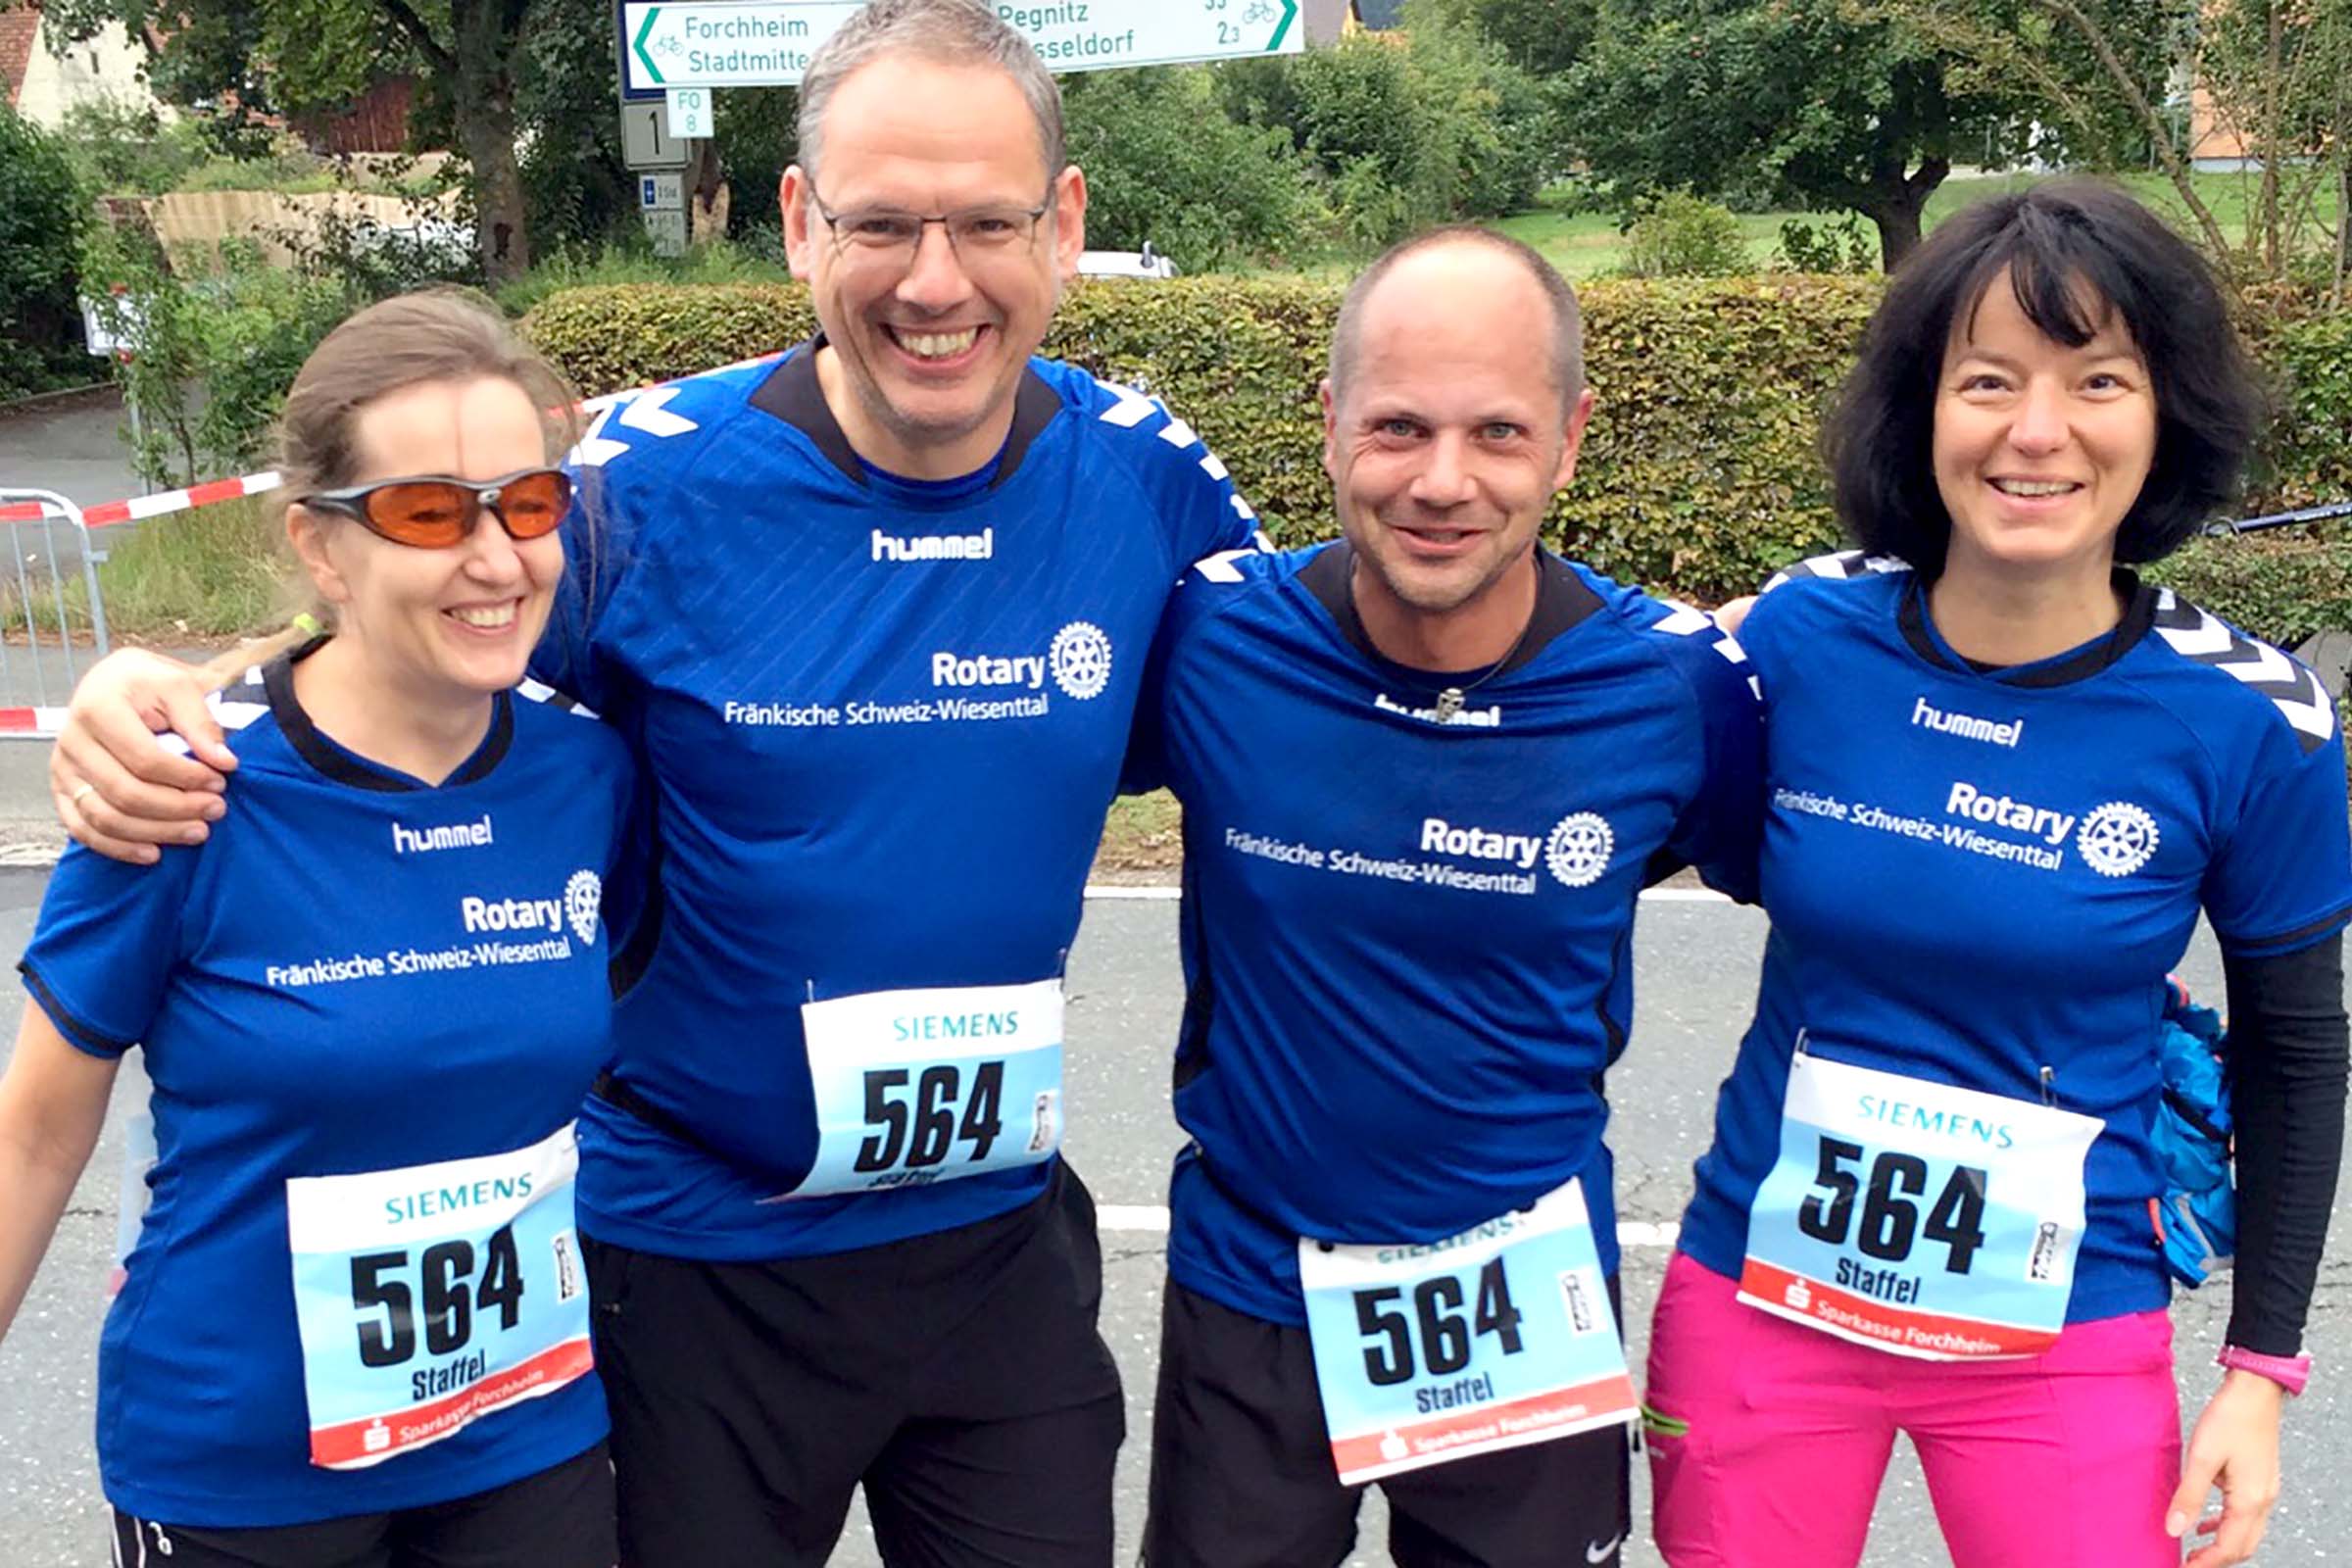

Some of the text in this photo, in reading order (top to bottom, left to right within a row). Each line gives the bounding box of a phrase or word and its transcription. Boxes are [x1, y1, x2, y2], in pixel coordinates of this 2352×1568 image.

[685, 14, 808, 38] Forchheim
[999, 3, 1089, 32] Pegnitz
[689, 49, 809, 73] Stadtmitte
[1033, 29, 1135, 60] sseldorf
[677, 91, 701, 110] FO
[649, 111, 661, 155] 1
[685, 115, 697, 132] 8
[872, 527, 993, 562] hummel
[932, 653, 1045, 689] Rotary
[724, 694, 1049, 726] Fränkische Schweiz-Wiesenttal
[1912, 698, 2023, 747] hummel
[392, 814, 493, 854] hummel
[1946, 782, 2076, 845] Rotary
[1420, 818, 1543, 868] Rotary
[1848, 803, 2062, 870] Schweiz-Wiesenttal
[1226, 828, 1536, 895] Fränkische Schweiz-Wiesenttal
[463, 897, 563, 933] Rotary
[267, 936, 571, 987] Fränkische Schweiz-Wiesenttal
[893, 1011, 1019, 1041] SIEMENS
[854, 1060, 1005, 1172] 564
[1858, 1096, 2014, 1149] SIEMENS
[386, 1172, 533, 1224] SIEMENS
[1798, 1135, 1988, 1275] 564
[350, 1224, 524, 1368] 564
[1835, 1257, 1921, 1304] Staffel
[1352, 1254, 1524, 1386] 564
[1817, 1300, 2001, 1354] Sparkasse Forchheim
[412, 1348, 485, 1401] Staffel
[472, 1369, 545, 1409] Forchheim
[1415, 1372, 1494, 1414] Staffel
